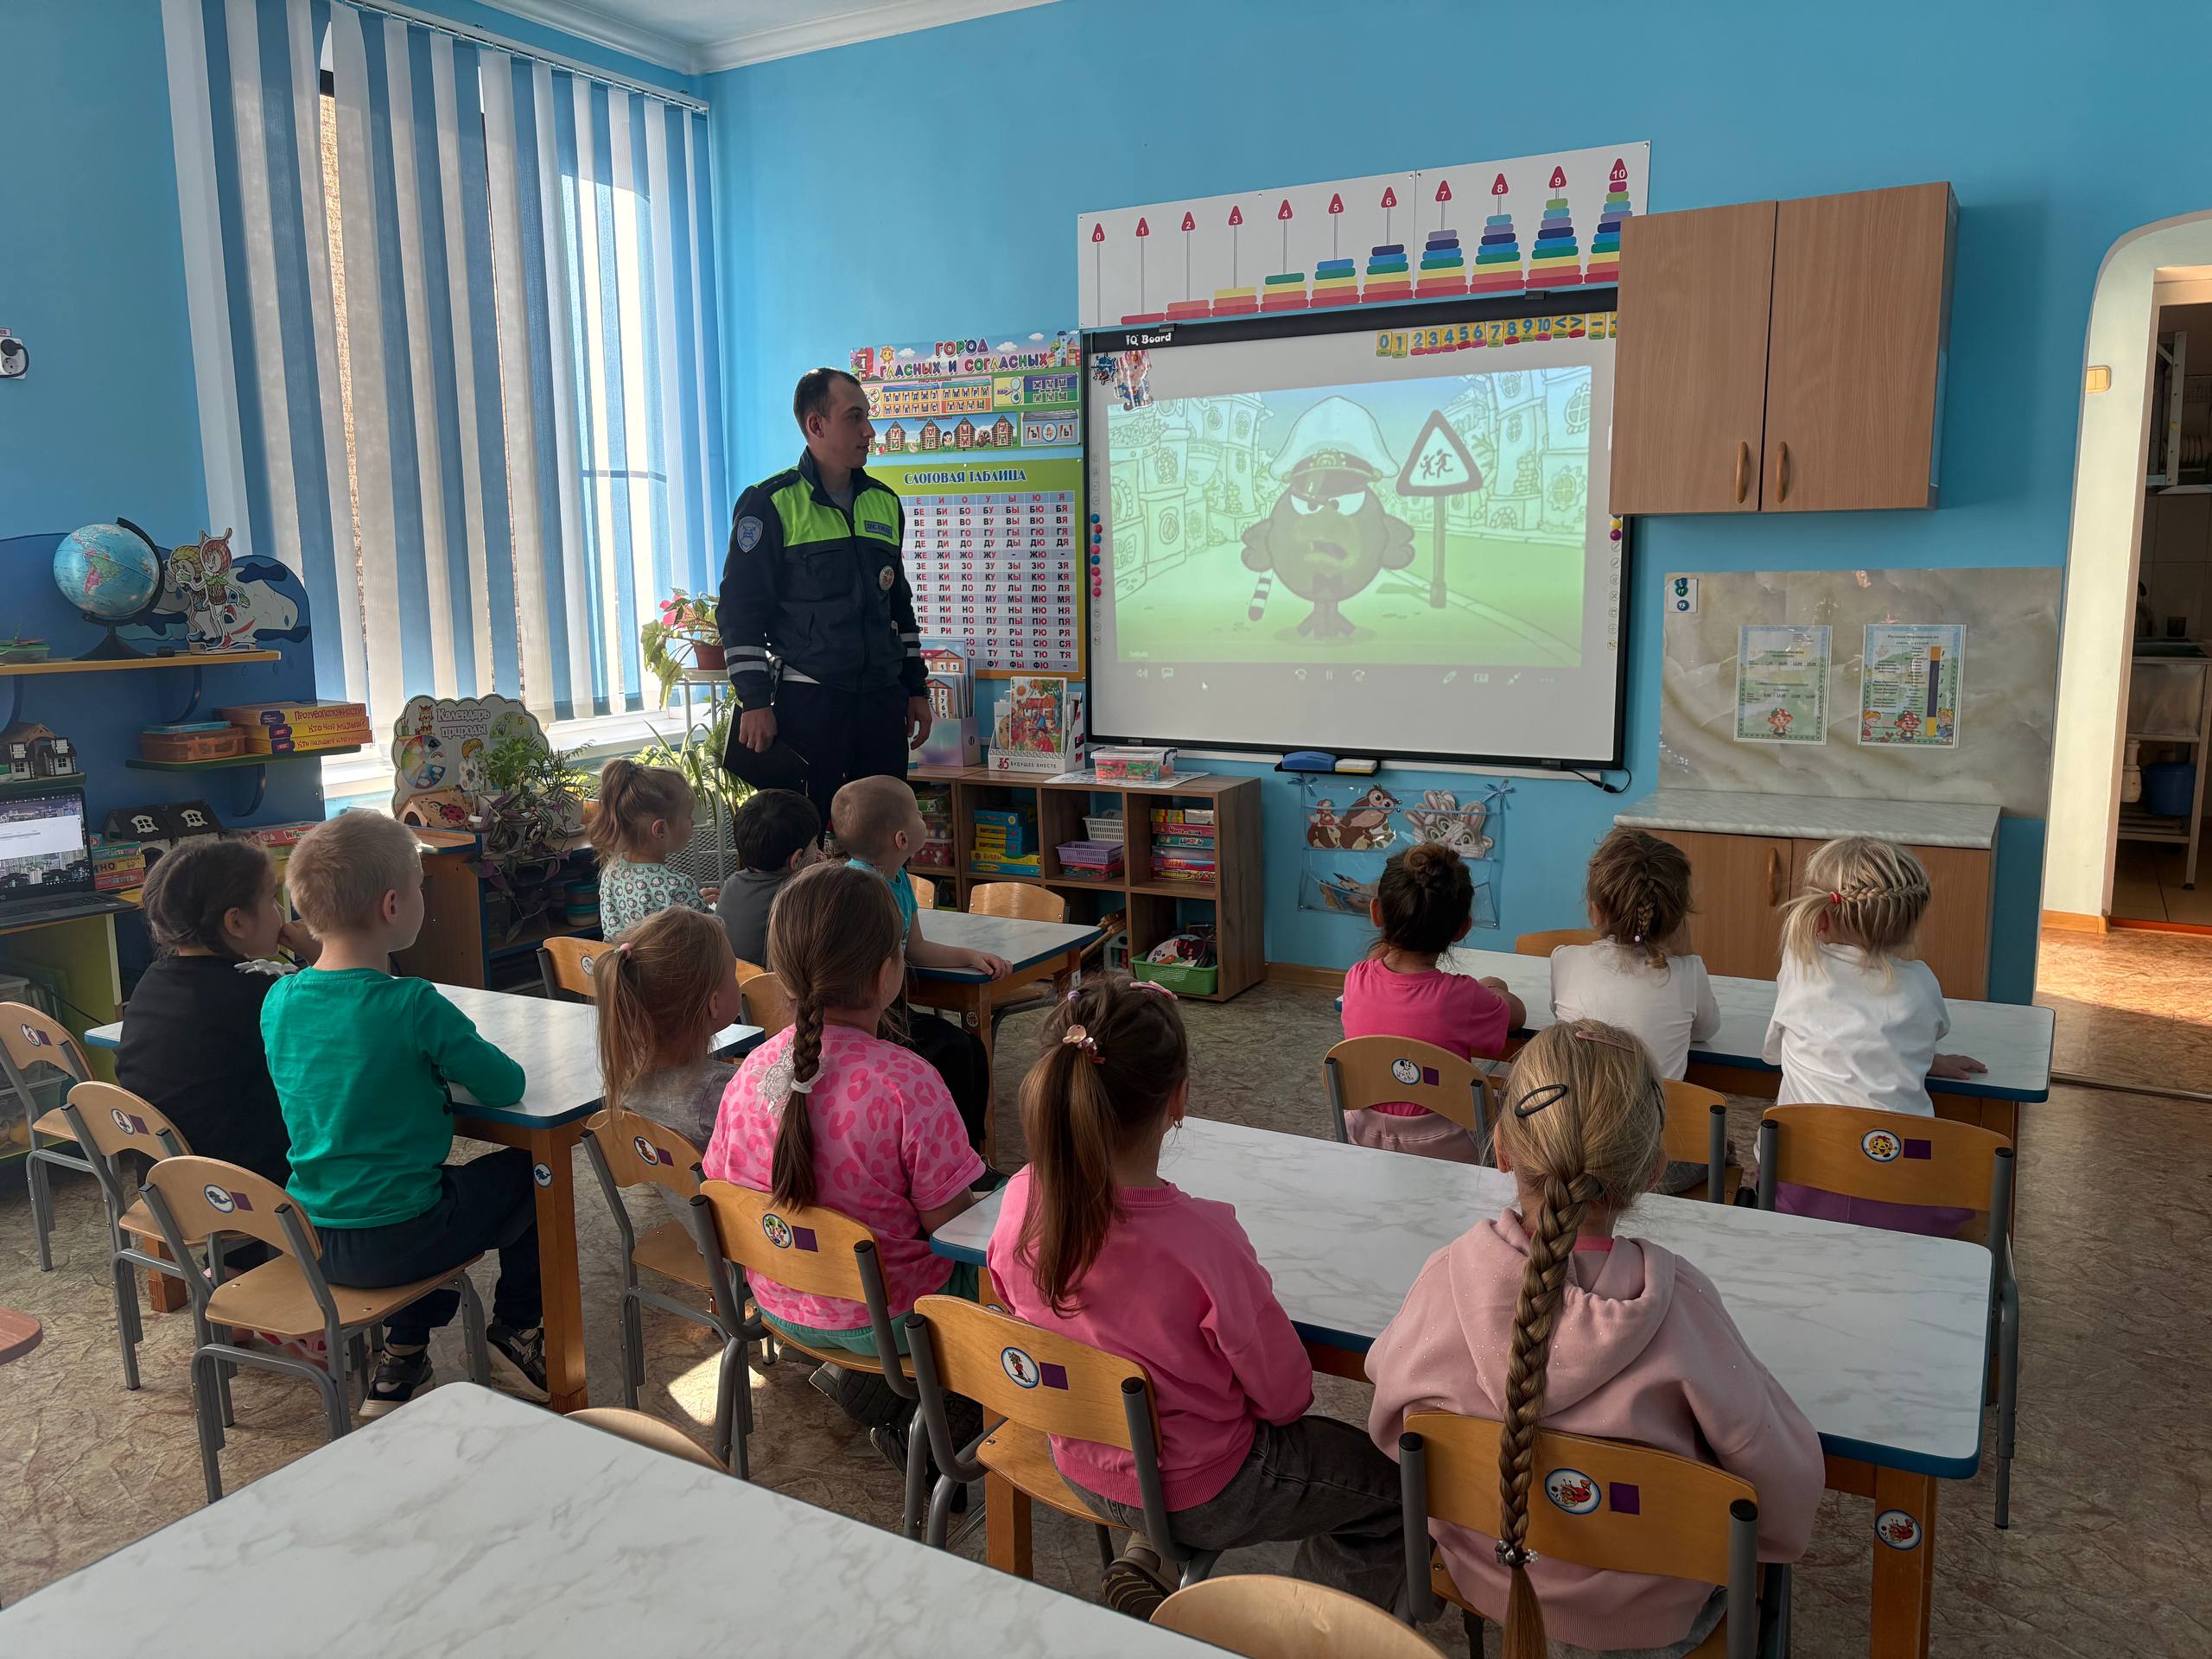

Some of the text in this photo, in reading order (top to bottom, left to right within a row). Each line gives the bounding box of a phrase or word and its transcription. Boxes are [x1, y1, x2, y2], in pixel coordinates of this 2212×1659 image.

[1096, 169, 1625, 241] 0 1 2 3 4 5 6 7 8 9 10
[1141, 332, 1172, 344] Board
[1380, 318, 1552, 348] 0 1 2 3 4 5 6 7 8 9 10
[936, 338, 988, 356] ГОРОД
[880, 353, 1048, 378] ГЛАСНЫХ И СОГЛАСНЫХ
[904, 469, 1027, 484] СЛОГОВАЯ ТАБЛИЦА
[916, 497, 922, 505] Е
[1008, 494, 1017, 503] Ы
[1032, 493, 1041, 502] Ю
[1058, 493, 1065, 501] Я
[936, 507, 948, 516] БИ
[1005, 505, 1020, 514] БЫ
[1029, 505, 1045, 513] БЮ
[913, 518, 925, 527] ВЕ
[959, 518, 971, 526] ВО
[1006, 517, 1020, 525] ВЫ
[1056, 516, 1068, 524] ВЯ
[960, 529, 971, 537] ГО
[1006, 528, 1020, 537] ГЫ
[1056, 527, 1068, 536] ГЯ
[914, 538, 1069, 550] ДЕ ДИ ДО ДУ ДЫ ДЮ ДЯ
[914, 551, 927, 560] ЖЕ
[983, 550, 996, 559] ЖУ
[961, 562, 973, 570] ЗО
[985, 562, 995, 570] ЗУ
[1007, 562, 1021, 570] ЗЫ
[1031, 562, 1046, 570] ЗЮ
[961, 573, 973, 582] КО
[1007, 573, 1021, 582] КЫ
[916, 583, 928, 592] ЛЕ
[961, 594, 975, 603] МО
[985, 594, 997, 603] МУ
[939, 605, 951, 613] НИ
[1007, 606, 1022, 614] НЫ
[1058, 607, 1071, 615] НЯ
[962, 616, 975, 625] ПО
[1032, 617, 1047, 626] ПЮ
[918, 626, 929, 635] РЕ
[987, 627, 997, 636] РУ
[1033, 628, 1047, 637] РЮ
[1009, 639, 1023, 647] СЫ
[1033, 639, 1048, 648] СЮ
[1058, 639, 1071, 648] СЯ
[988, 649, 998, 658] ТУ
[1059, 651, 1071, 659] ТЯ
[1033, 661, 1049, 670] ФЮ
[436, 709, 491, 722] Календарь
[441, 725, 487, 739] природы
